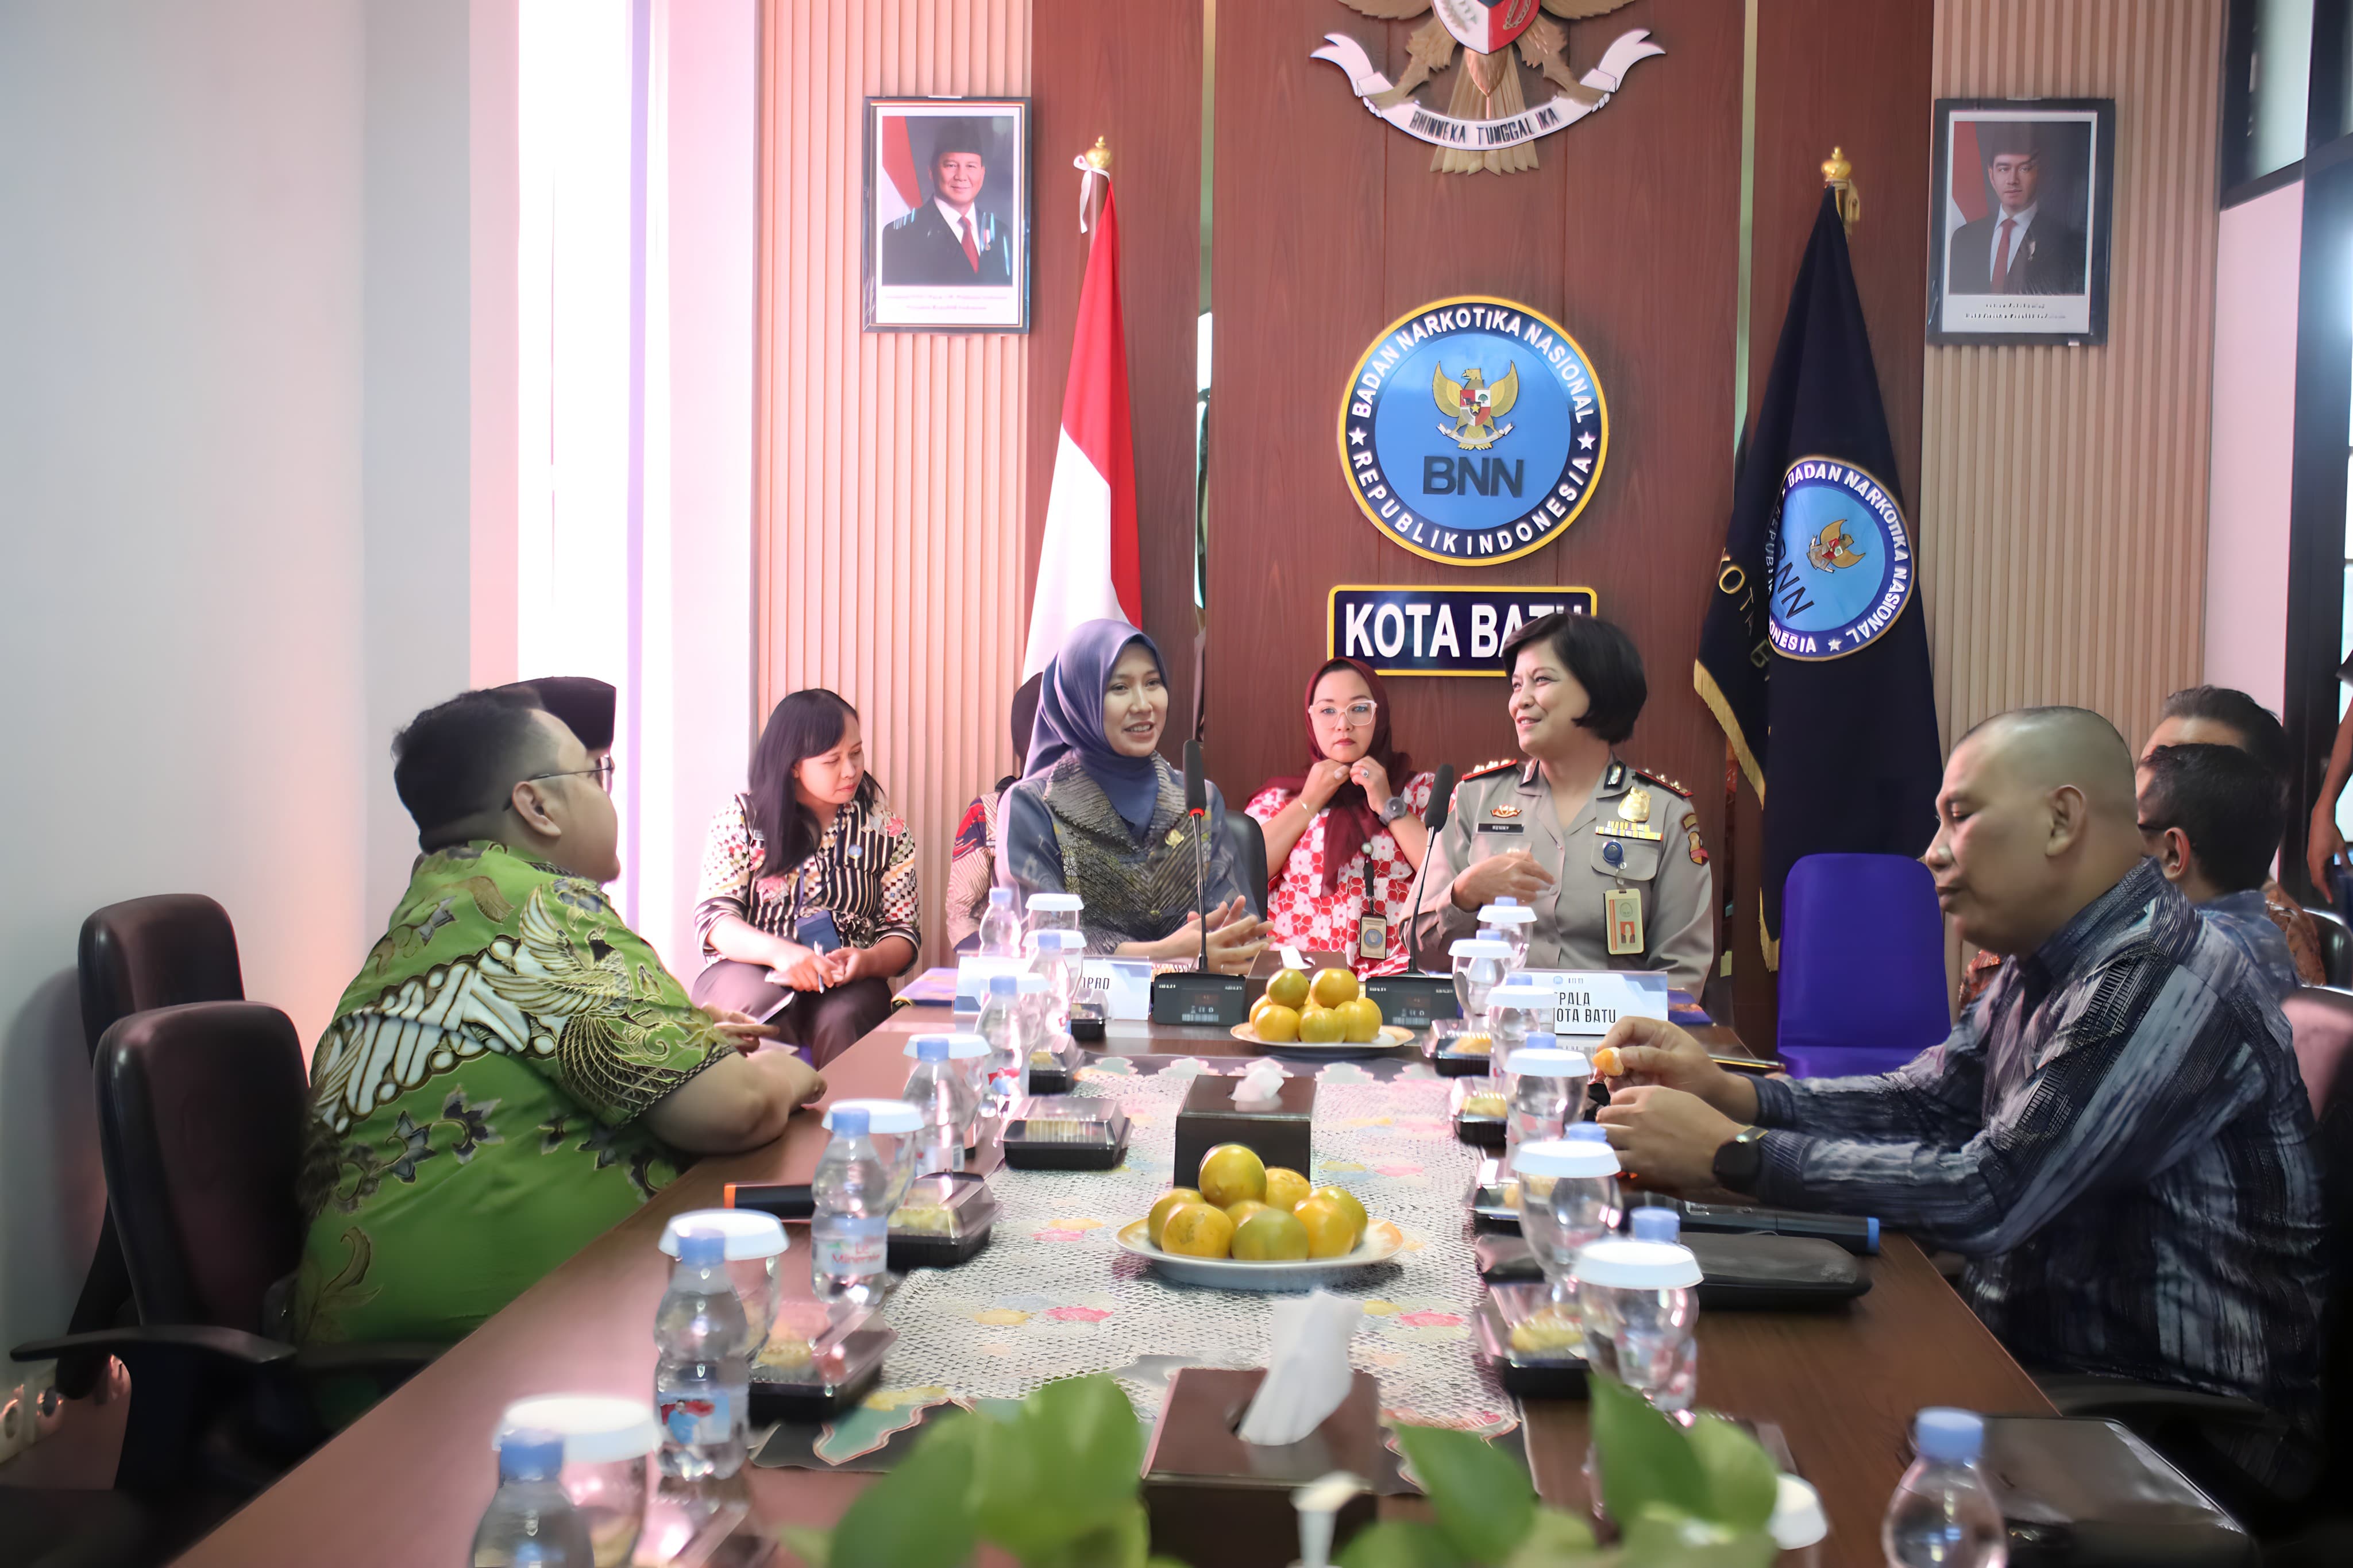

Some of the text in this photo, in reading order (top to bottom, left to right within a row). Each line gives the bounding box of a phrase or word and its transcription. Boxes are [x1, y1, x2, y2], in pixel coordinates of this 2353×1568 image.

[1409, 107, 1560, 145] BHINNEKA TUNGGAL IKA
[1352, 308, 1594, 423] BADAN NARKOTIKA NASIONAL
[1422, 455, 1523, 497] BNN
[1353, 450, 1592, 555] REPUBLIK INDONESIA
[1788, 464, 1908, 643] BADAN NARKOTIKA NASIONAL
[1345, 604, 1582, 658] KOTA BA
[1769, 616, 1816, 653] ONESIA
[1554, 992, 1590, 1006] PALA
[1557, 1008, 1616, 1023] OTA BATU
